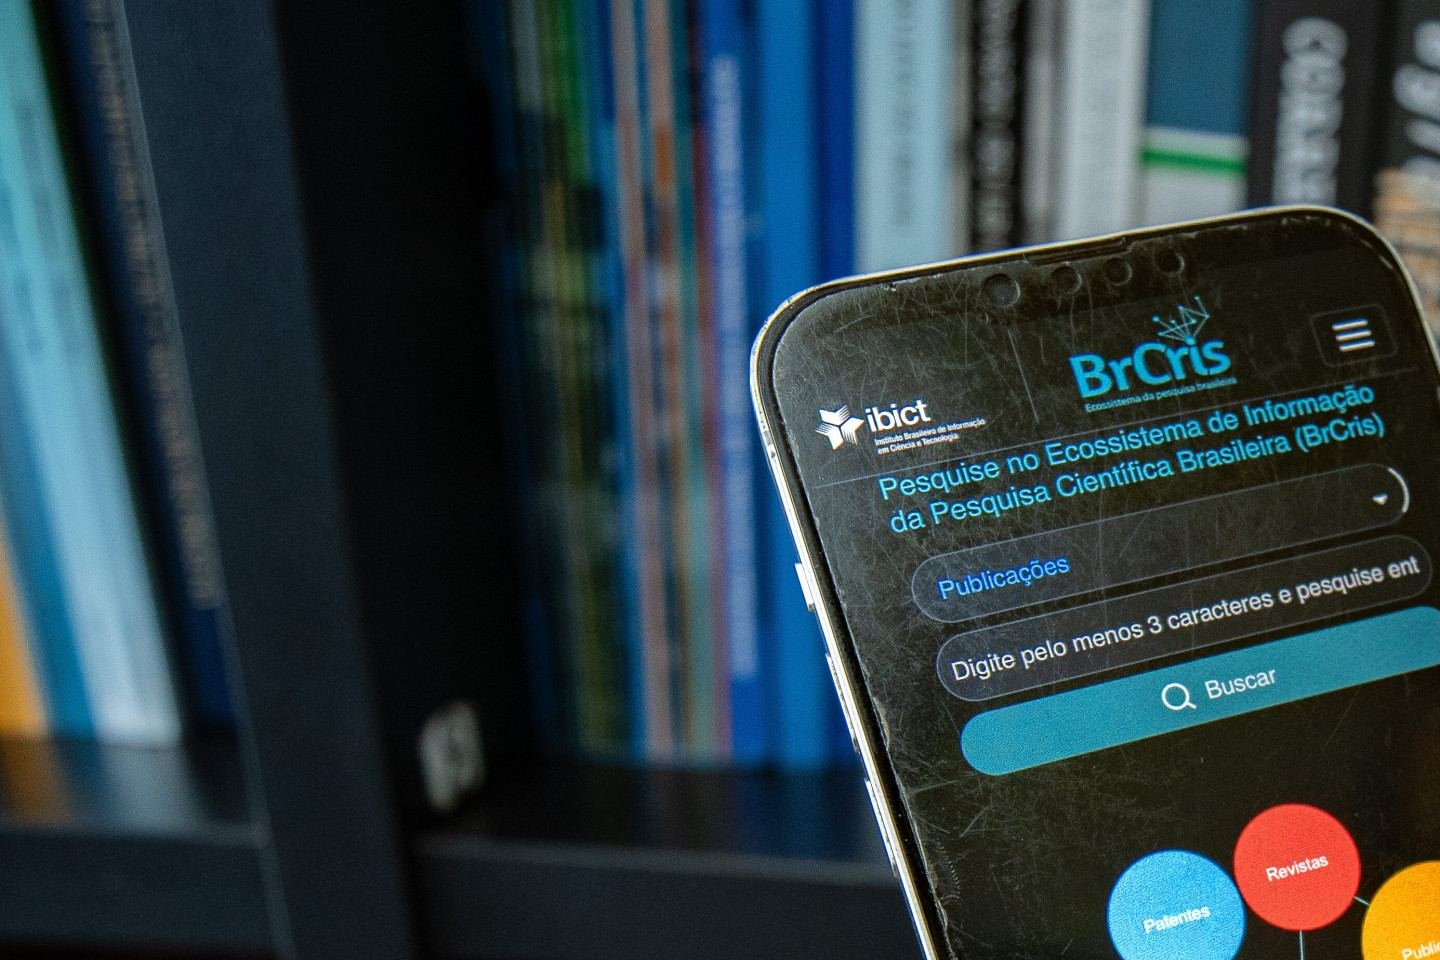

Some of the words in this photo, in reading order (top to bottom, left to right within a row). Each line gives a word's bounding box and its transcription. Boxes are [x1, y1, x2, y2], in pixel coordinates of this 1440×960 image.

[1069, 336, 1231, 398] BrCris
[1084, 396, 1142, 413] Ecossistema
[1143, 392, 1155, 401] da
[1156, 384, 1196, 401] pesquisa
[1196, 376, 1238, 391] brasileira
[864, 397, 931, 433] ibict
[874, 434, 903, 446] Instituto
[947, 418, 986, 432] Informação
[878, 461, 1000, 500] Pesquise
[1006, 452, 1040, 475] no
[1045, 419, 1204, 466] Ecossistema
[1207, 410, 1239, 434] de
[1243, 385, 1375, 426] Informação
[878, 446, 890, 454] em
[890, 441, 916, 453] Ciência
[890, 509, 926, 533] da
[929, 484, 1051, 524] Pesquisa
[1056, 459, 1174, 498] Científica
[1176, 434, 1292, 472] Brasileira
[1295, 412, 1385, 453] (BrCris)
[937, 556, 1070, 601] Publicações
[951, 651, 1016, 682] Digite
[1020, 639, 1067, 670] pelo
[1072, 621, 1144, 660] menos
[1148, 616, 1163, 636] 3
[1166, 591, 1274, 631] caracteres
[1278, 589, 1293, 606] e
[1296, 564, 1384, 605] pesquise
[1389, 555, 1419, 579] ent
[1205, 667, 1277, 700] Buscar
[1265, 854, 1328, 882] Revistas
[1143, 905, 1211, 934] Patentes
